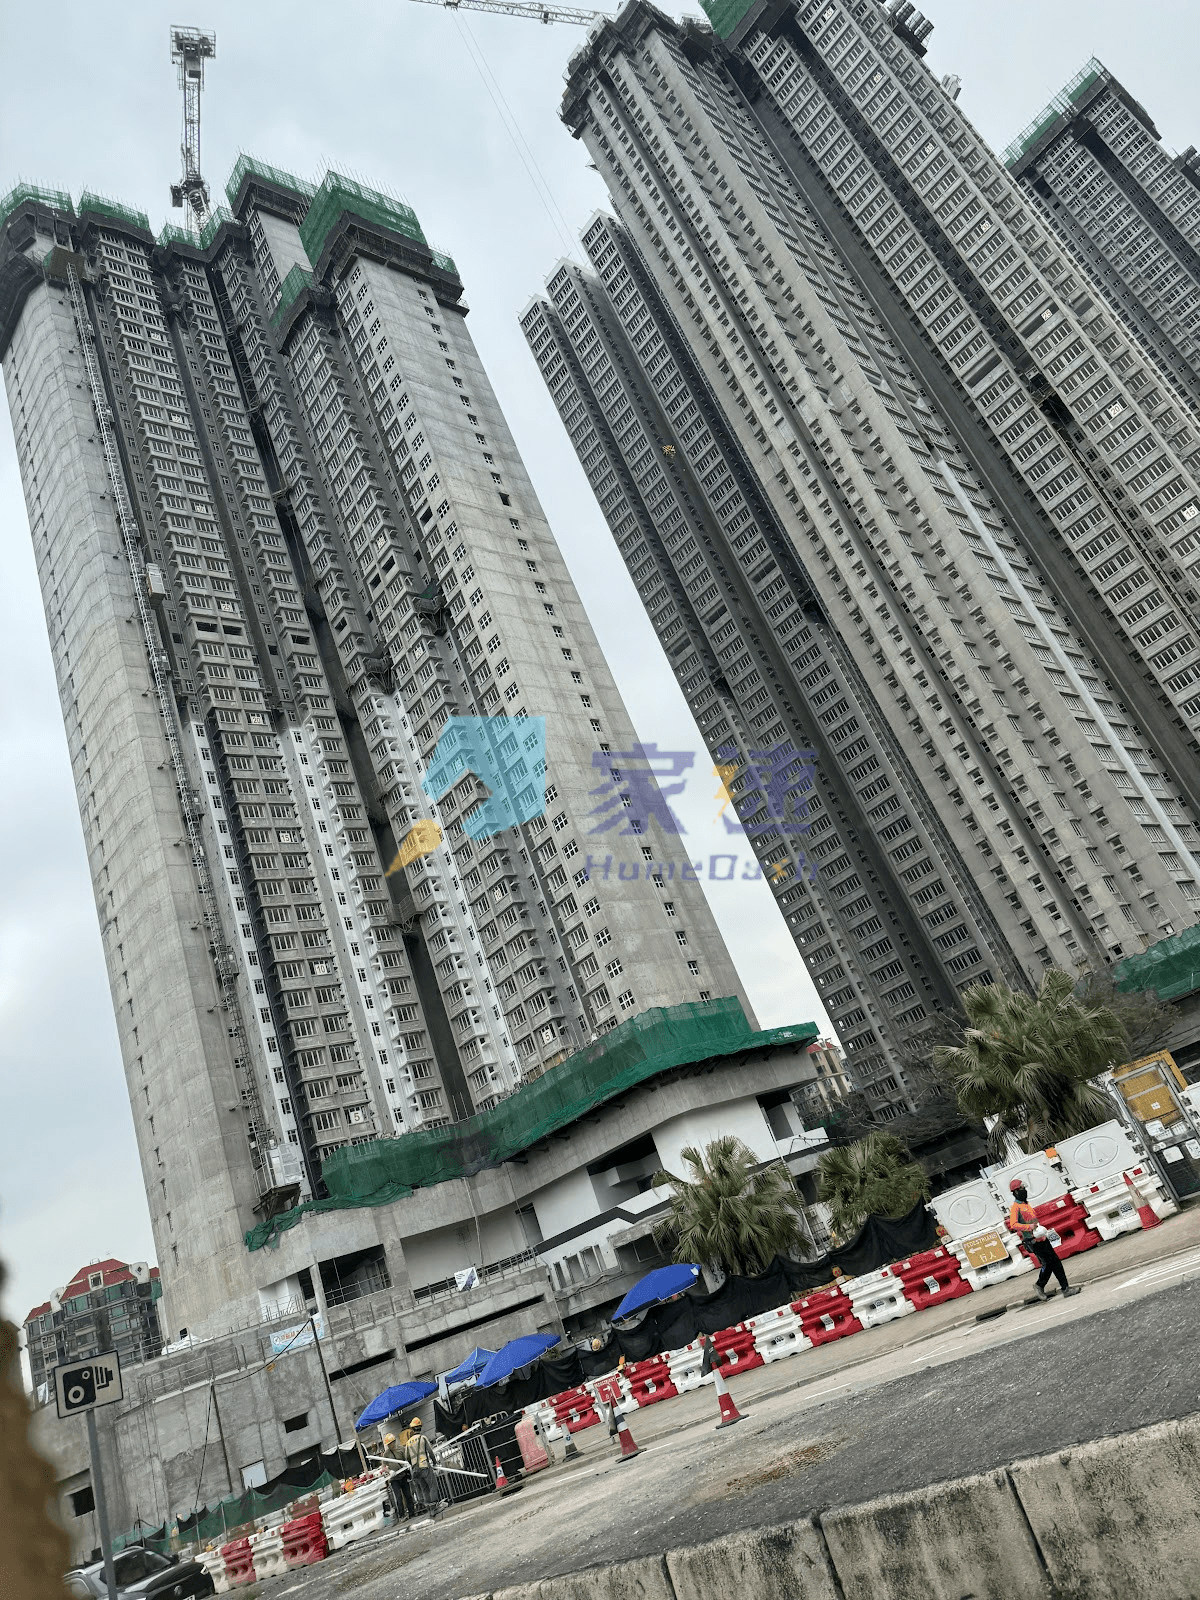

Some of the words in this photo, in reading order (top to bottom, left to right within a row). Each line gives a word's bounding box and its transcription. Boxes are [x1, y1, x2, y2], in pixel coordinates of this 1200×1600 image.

[1042, 310, 1051, 319] 25
[1111, 406, 1120, 416] 20
[1186, 508, 1196, 518] 15
[317, 965, 326, 974] 10
[354, 1112, 360, 1121] 5
